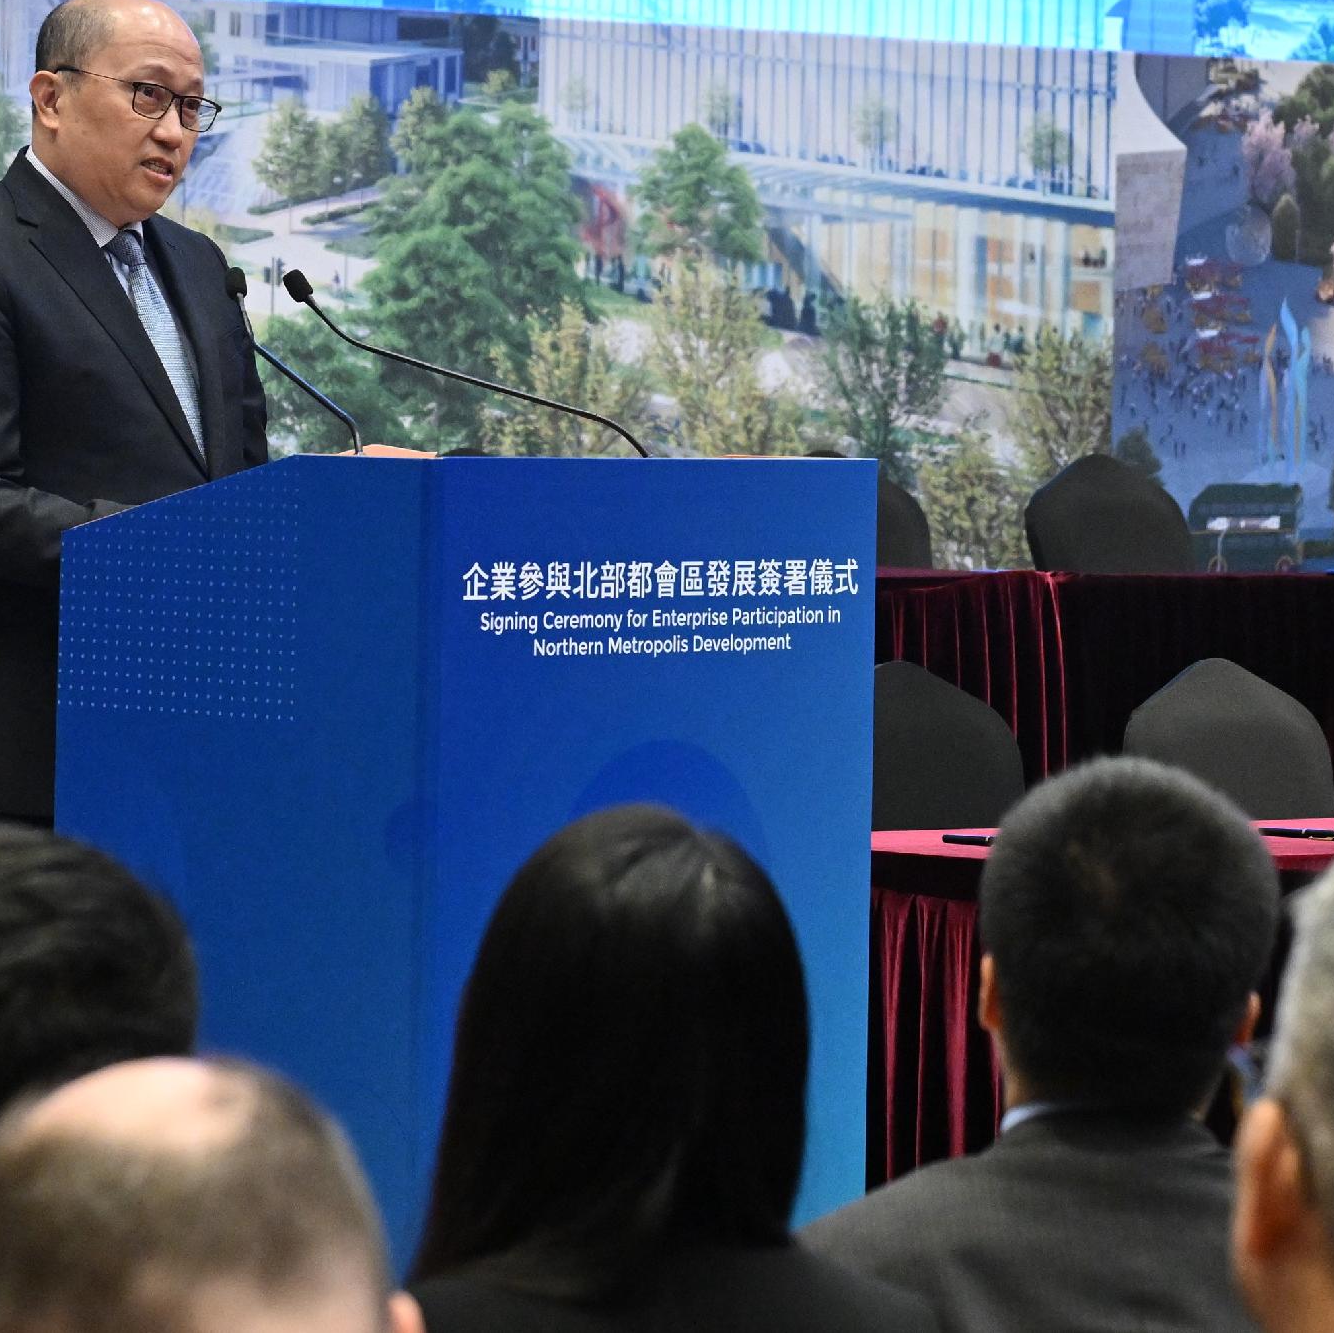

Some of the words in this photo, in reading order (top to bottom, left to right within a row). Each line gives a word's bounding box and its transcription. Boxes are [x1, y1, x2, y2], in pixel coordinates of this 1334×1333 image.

[462, 558, 859, 602] 企業參與北部都會區發展簽署儀式
[480, 612, 538, 634] Signing
[543, 610, 623, 633] Ceremony
[627, 609, 648, 628] for
[652, 608, 728, 630] Enterprise
[732, 605, 824, 628] Participation
[828, 605, 841, 624] in
[533, 637, 604, 657] Northern
[608, 635, 689, 659] Metropolis
[693, 633, 792, 654] Development
